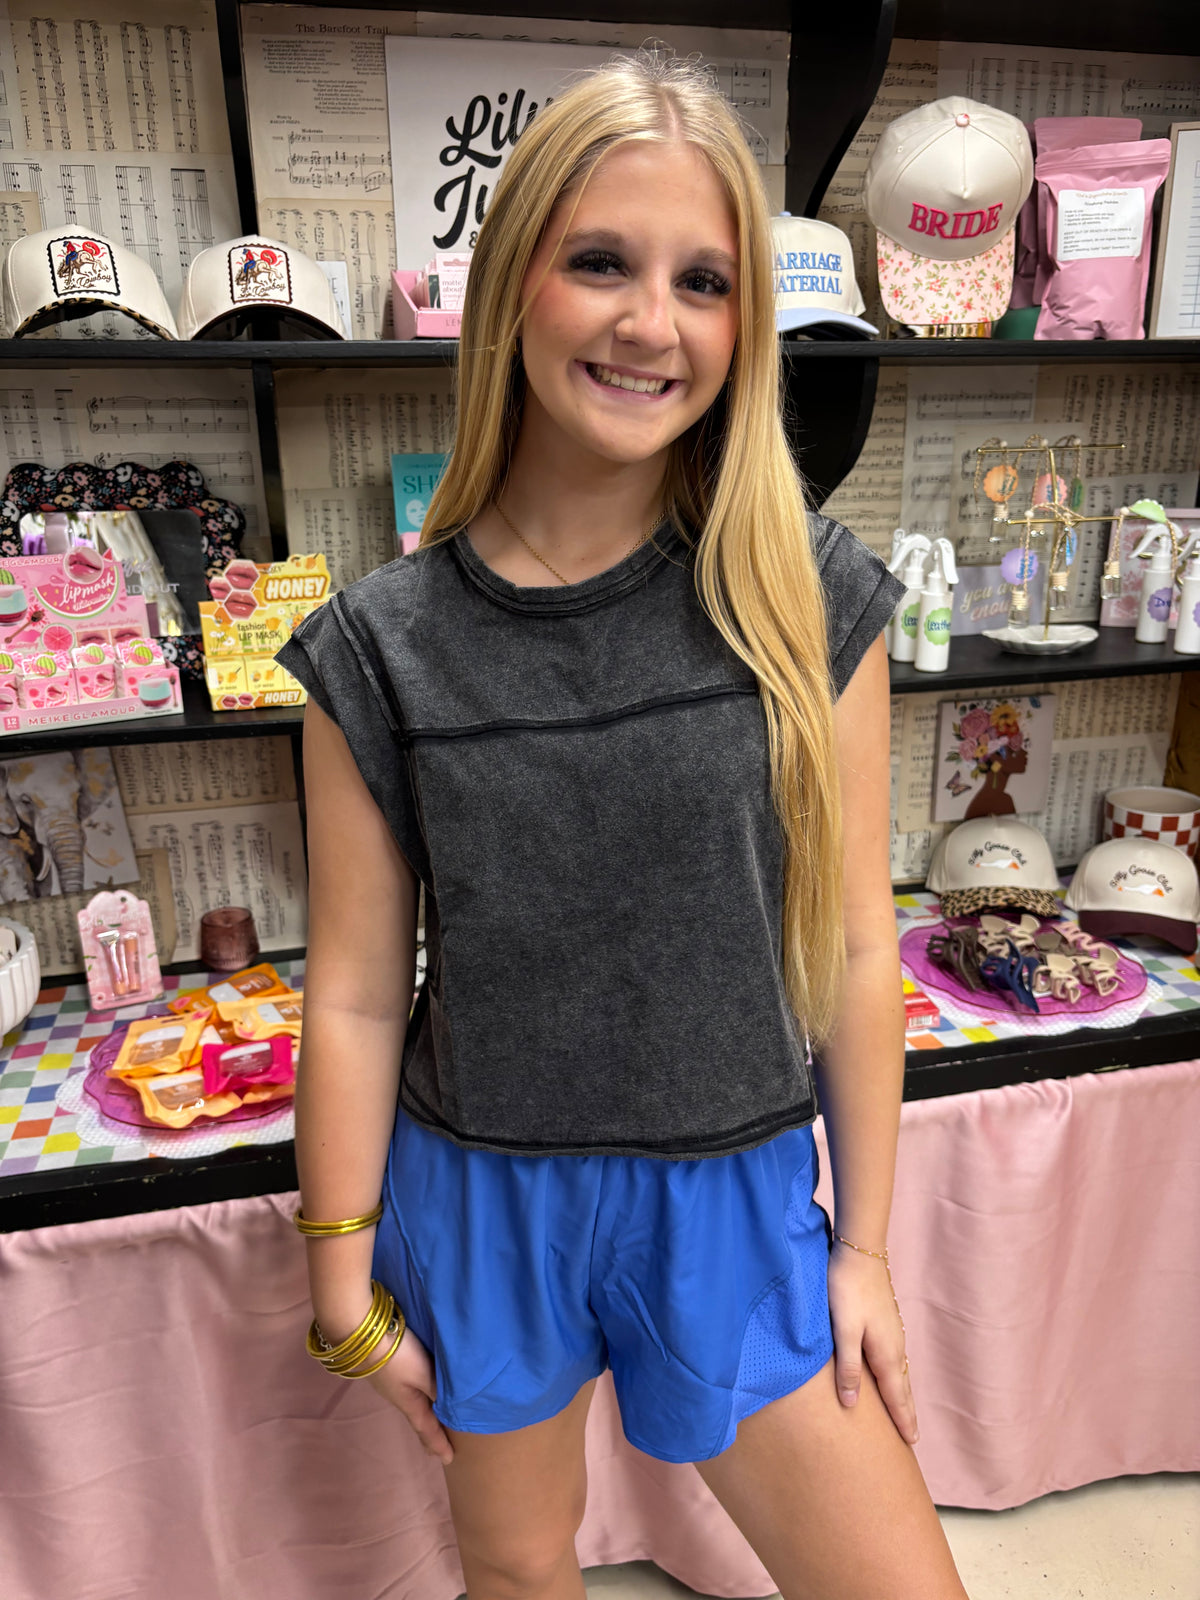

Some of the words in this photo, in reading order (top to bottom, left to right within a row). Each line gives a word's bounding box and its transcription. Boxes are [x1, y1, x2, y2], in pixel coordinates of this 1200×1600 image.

[296, 24, 315, 33] The
[319, 24, 361, 34] Barefoot
[908, 202, 1003, 239] BRIDE
[774, 252, 842, 272] ARRIAGE
[60, 572, 116, 607] lipmask
[265, 576, 326, 600] HONEY
[960, 586, 994, 613] you
[237, 622, 266, 632] fashion
[238, 633, 253, 641] LIP
[256, 631, 281, 640] MASK
[264, 691, 300, 704] HONEY
